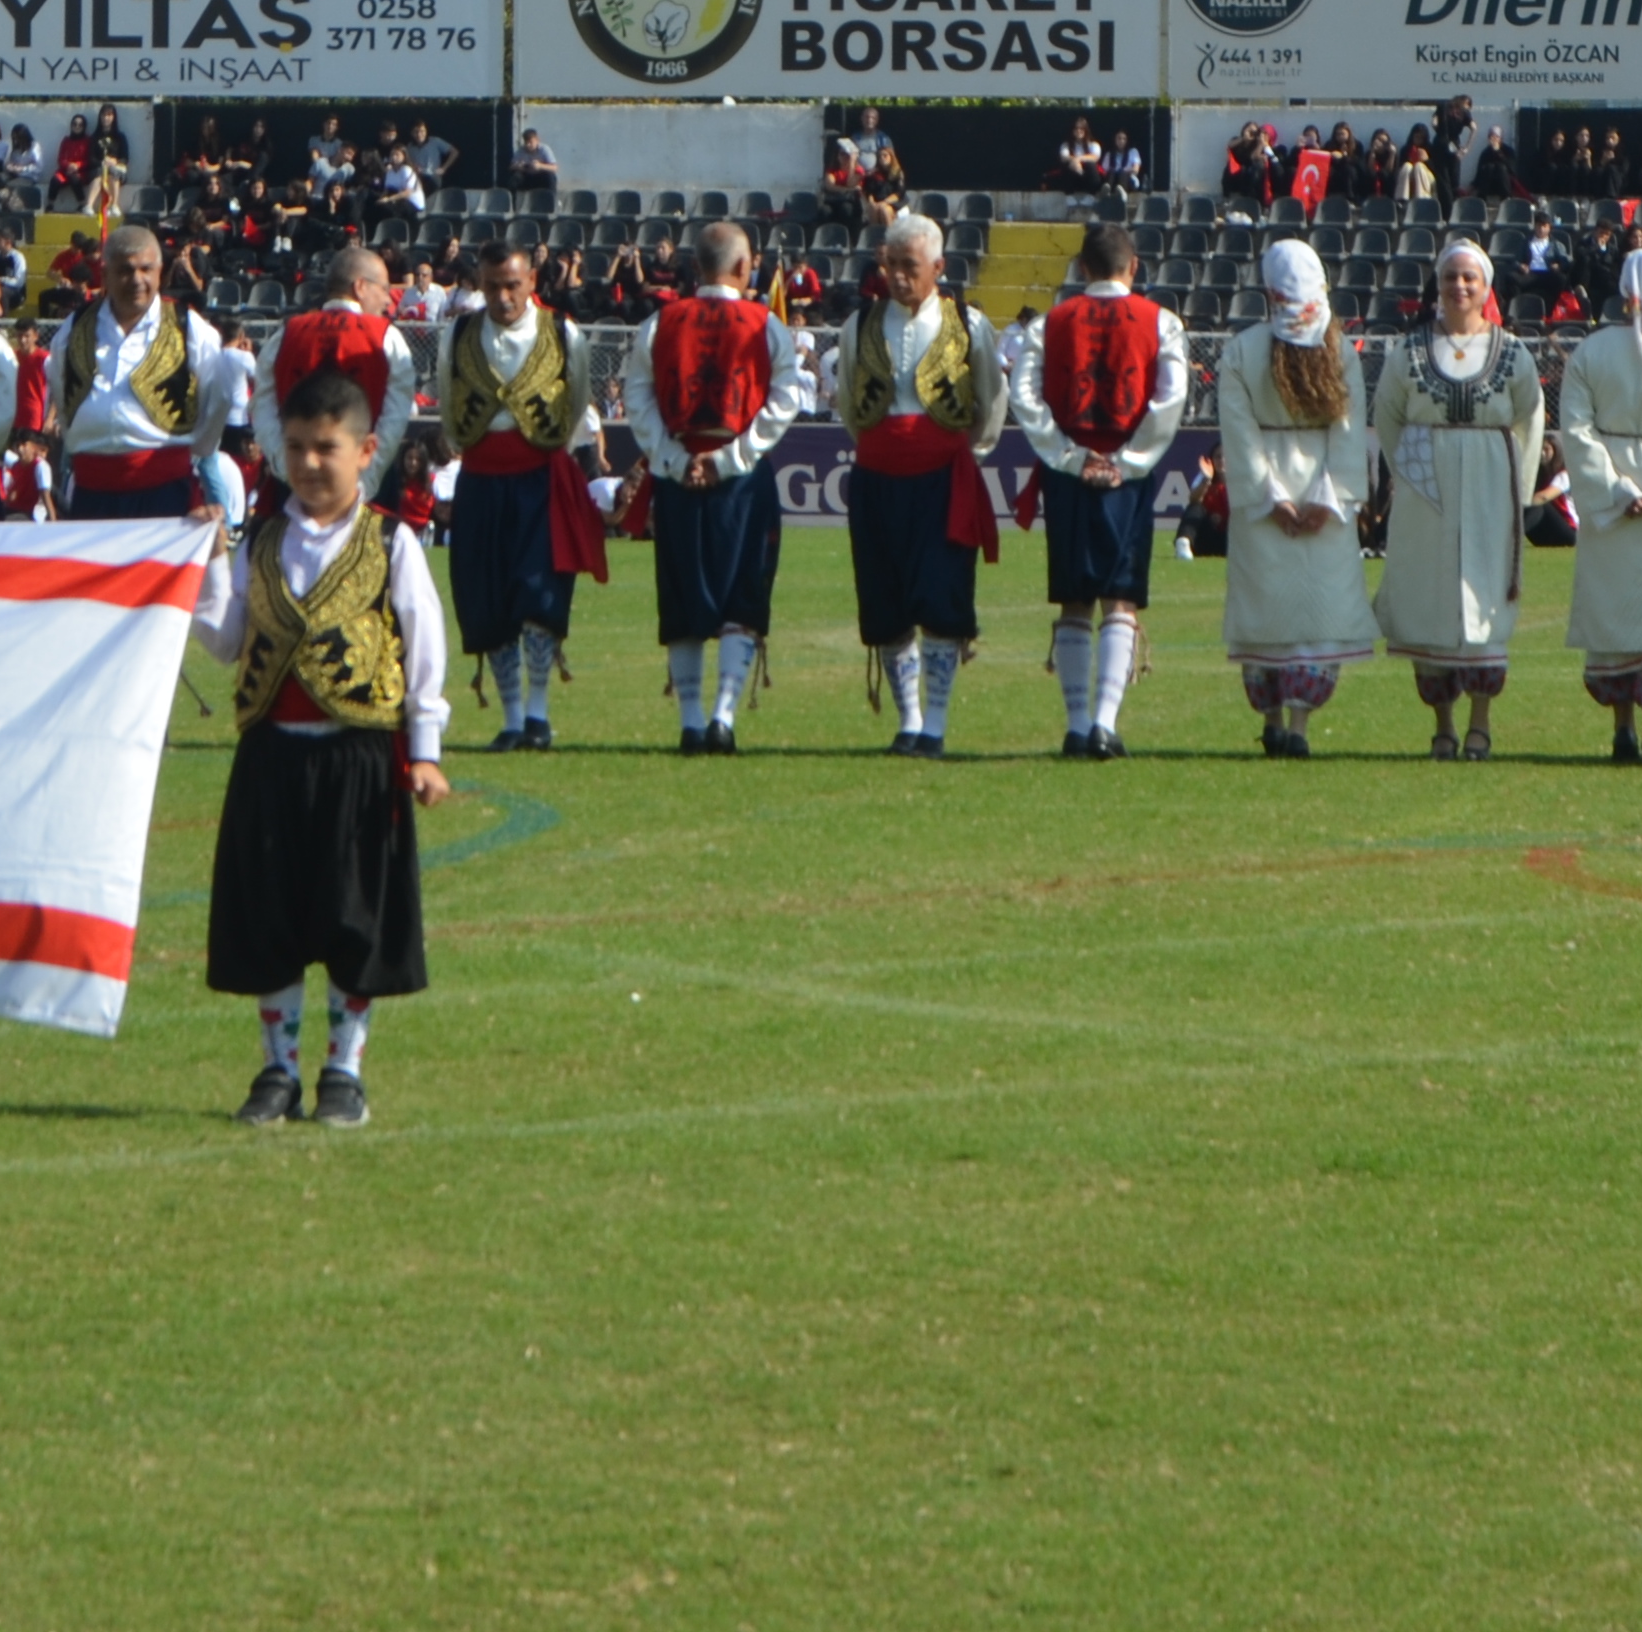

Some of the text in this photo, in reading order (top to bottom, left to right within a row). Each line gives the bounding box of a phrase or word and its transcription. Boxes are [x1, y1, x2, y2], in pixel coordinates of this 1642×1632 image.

[326, 27, 476, 51] 371 78 76
[780, 19, 1115, 73] BORSASI
[1219, 49, 1302, 65] 444 1 391
[1416, 39, 1620, 68] Kürşat Engin ÖZCAN
[41, 57, 118, 81] YAPI
[134, 57, 160, 82] &
[645, 60, 688, 78] 1966
[1432, 72, 1452, 83] T.C.
[1553, 72, 1605, 85] BAŞKANI
